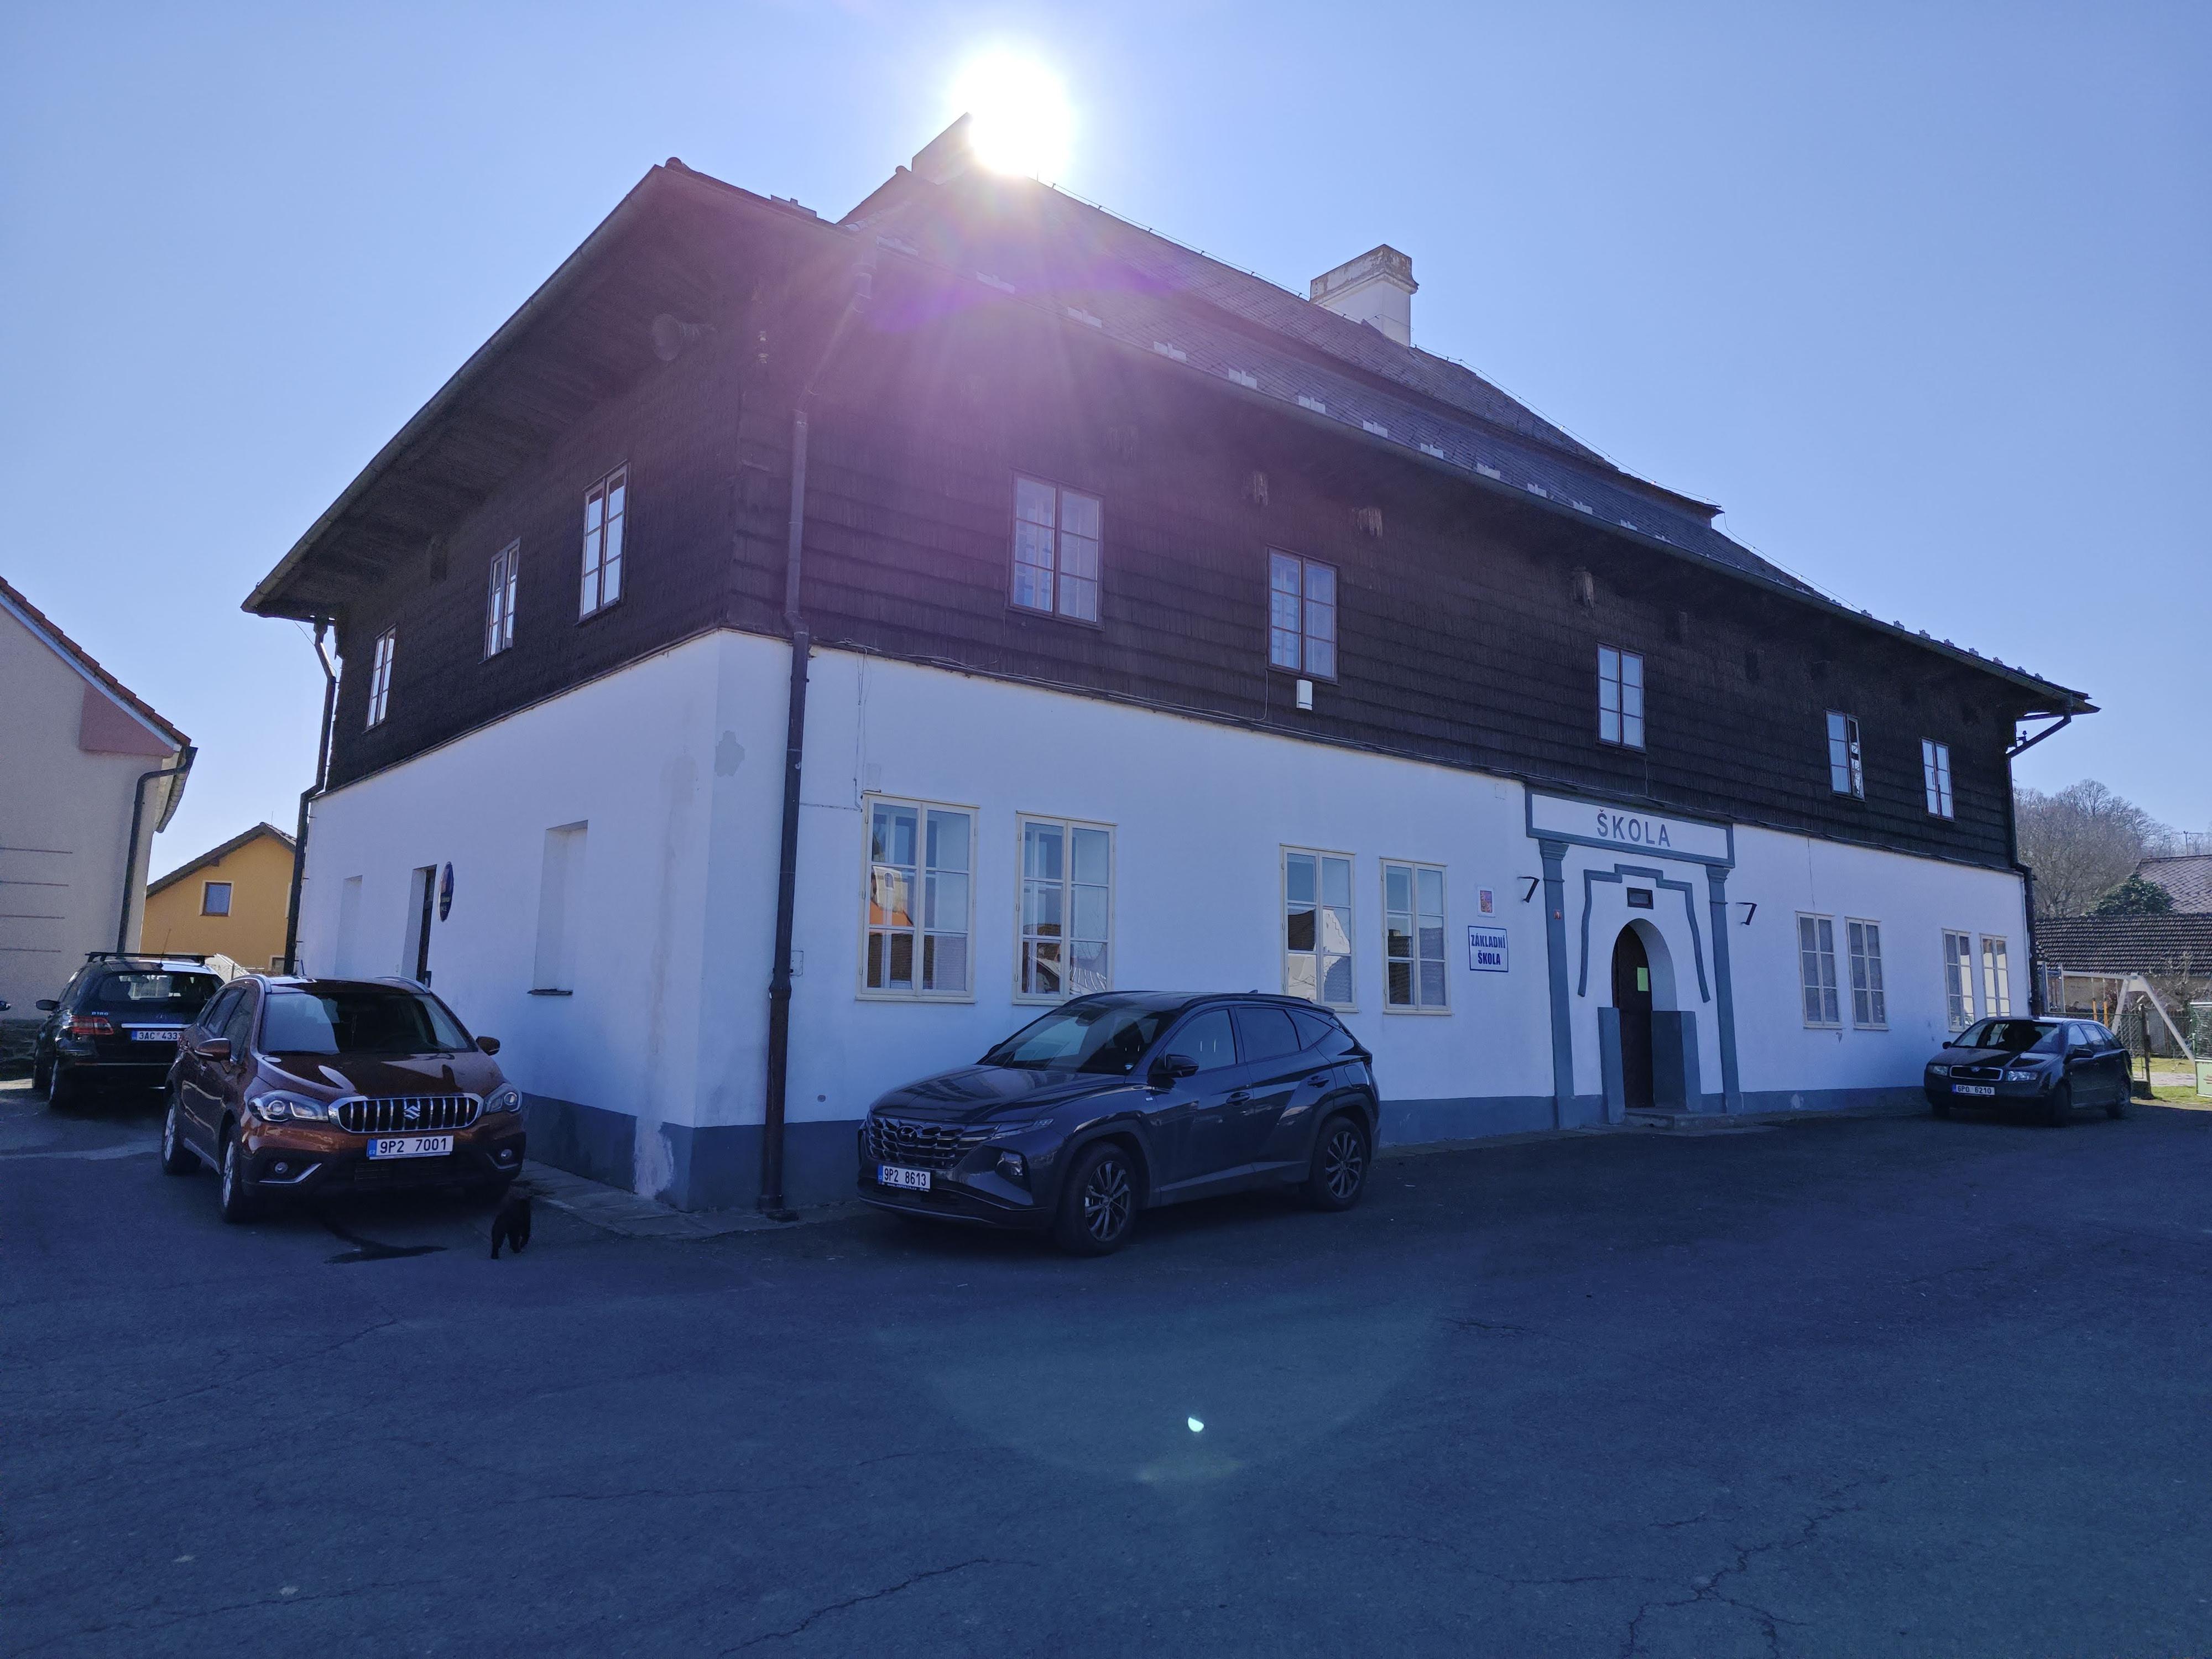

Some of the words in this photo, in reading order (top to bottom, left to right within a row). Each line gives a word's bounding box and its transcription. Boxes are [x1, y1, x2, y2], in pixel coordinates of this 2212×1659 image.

[1597, 809, 1671, 847] ŠKOLA
[1470, 933, 1506, 948] ZÁKLADNÍ
[1478, 950, 1501, 965] ŠKOLA
[380, 1140, 405, 1154] 9P2
[415, 1138, 447, 1152] 7001
[884, 1168, 899, 1182] 9P2
[905, 1171, 926, 1186] 8613
